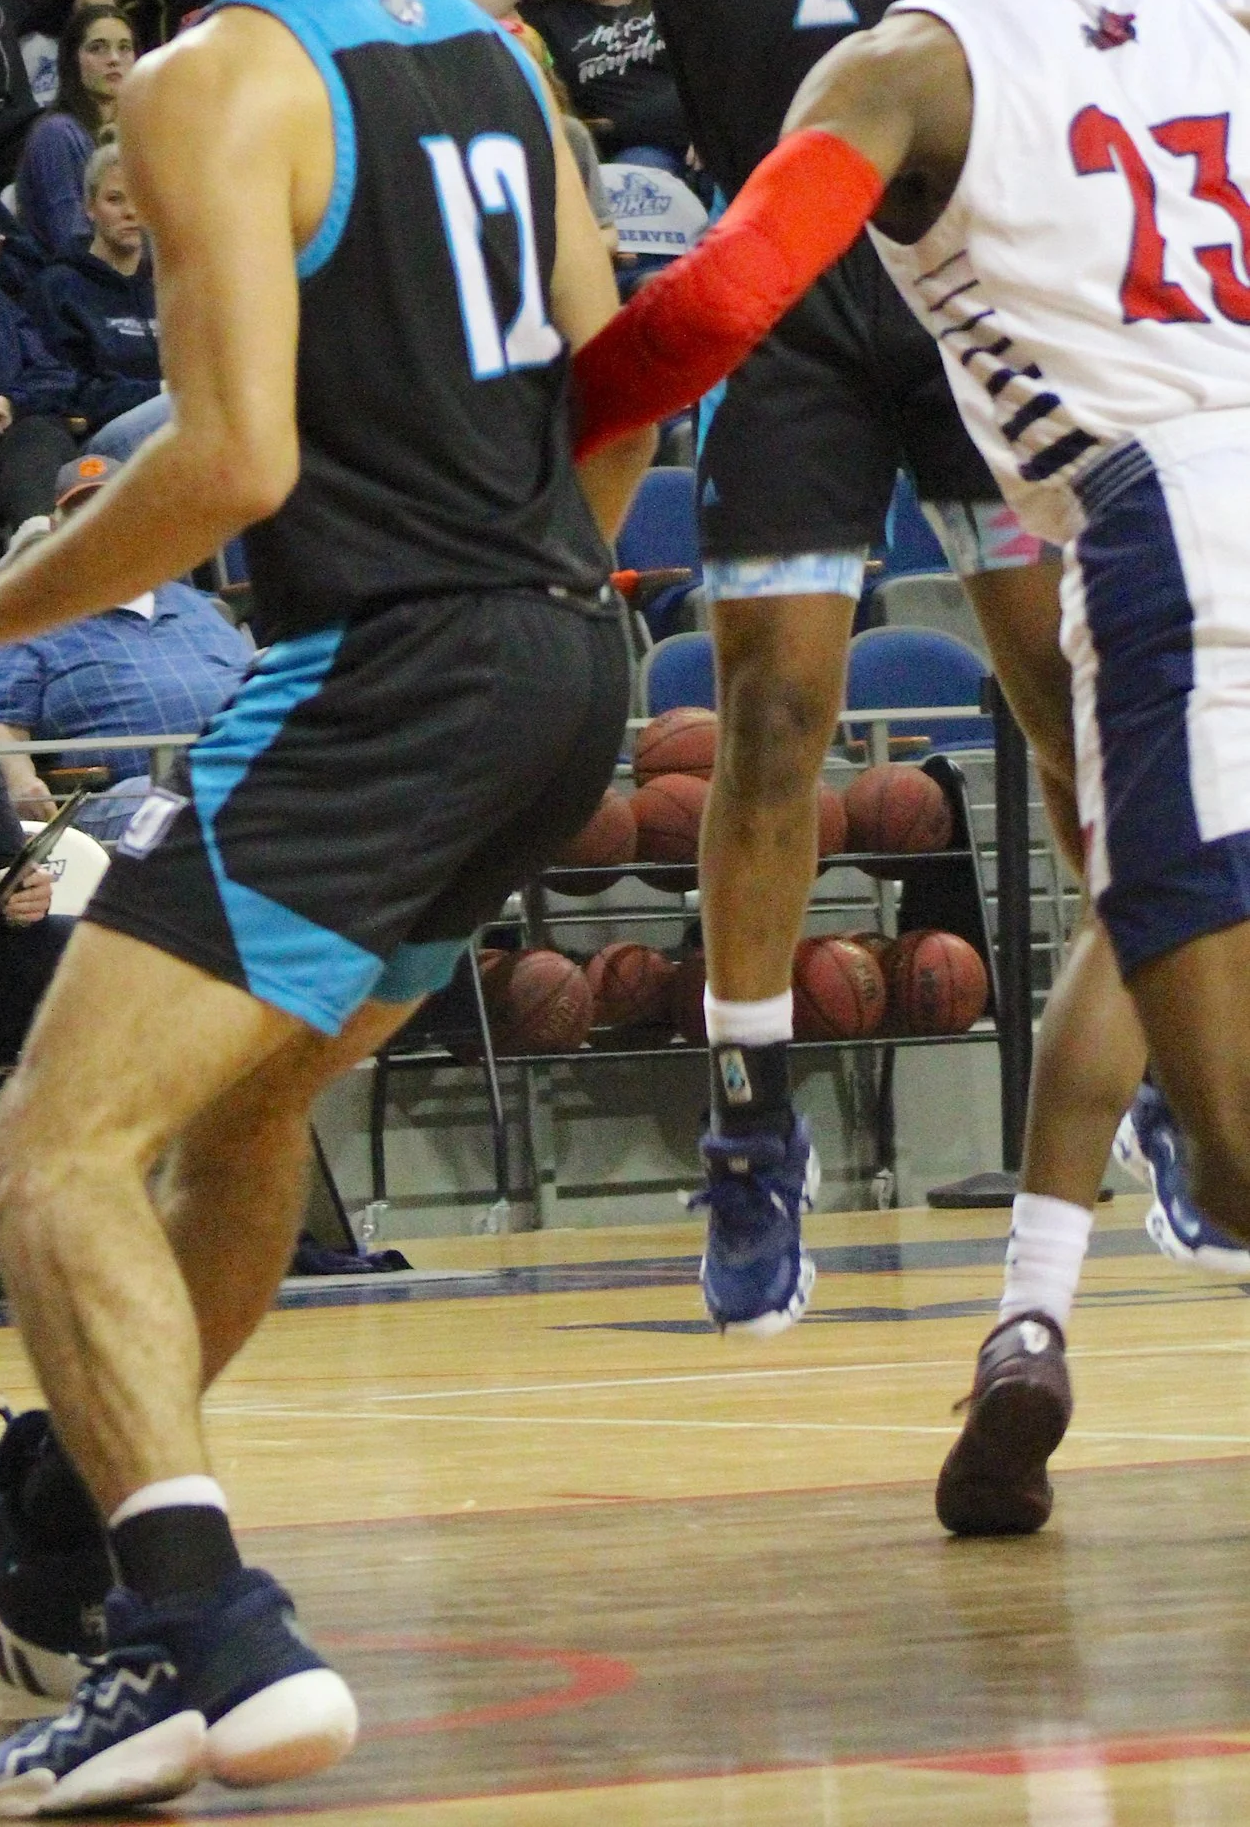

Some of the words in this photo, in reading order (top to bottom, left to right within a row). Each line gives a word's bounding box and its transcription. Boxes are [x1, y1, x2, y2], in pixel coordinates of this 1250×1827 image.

[419, 131, 566, 380] 12
[618, 230, 686, 243] SERVED
[1068, 104, 1250, 325] 23
